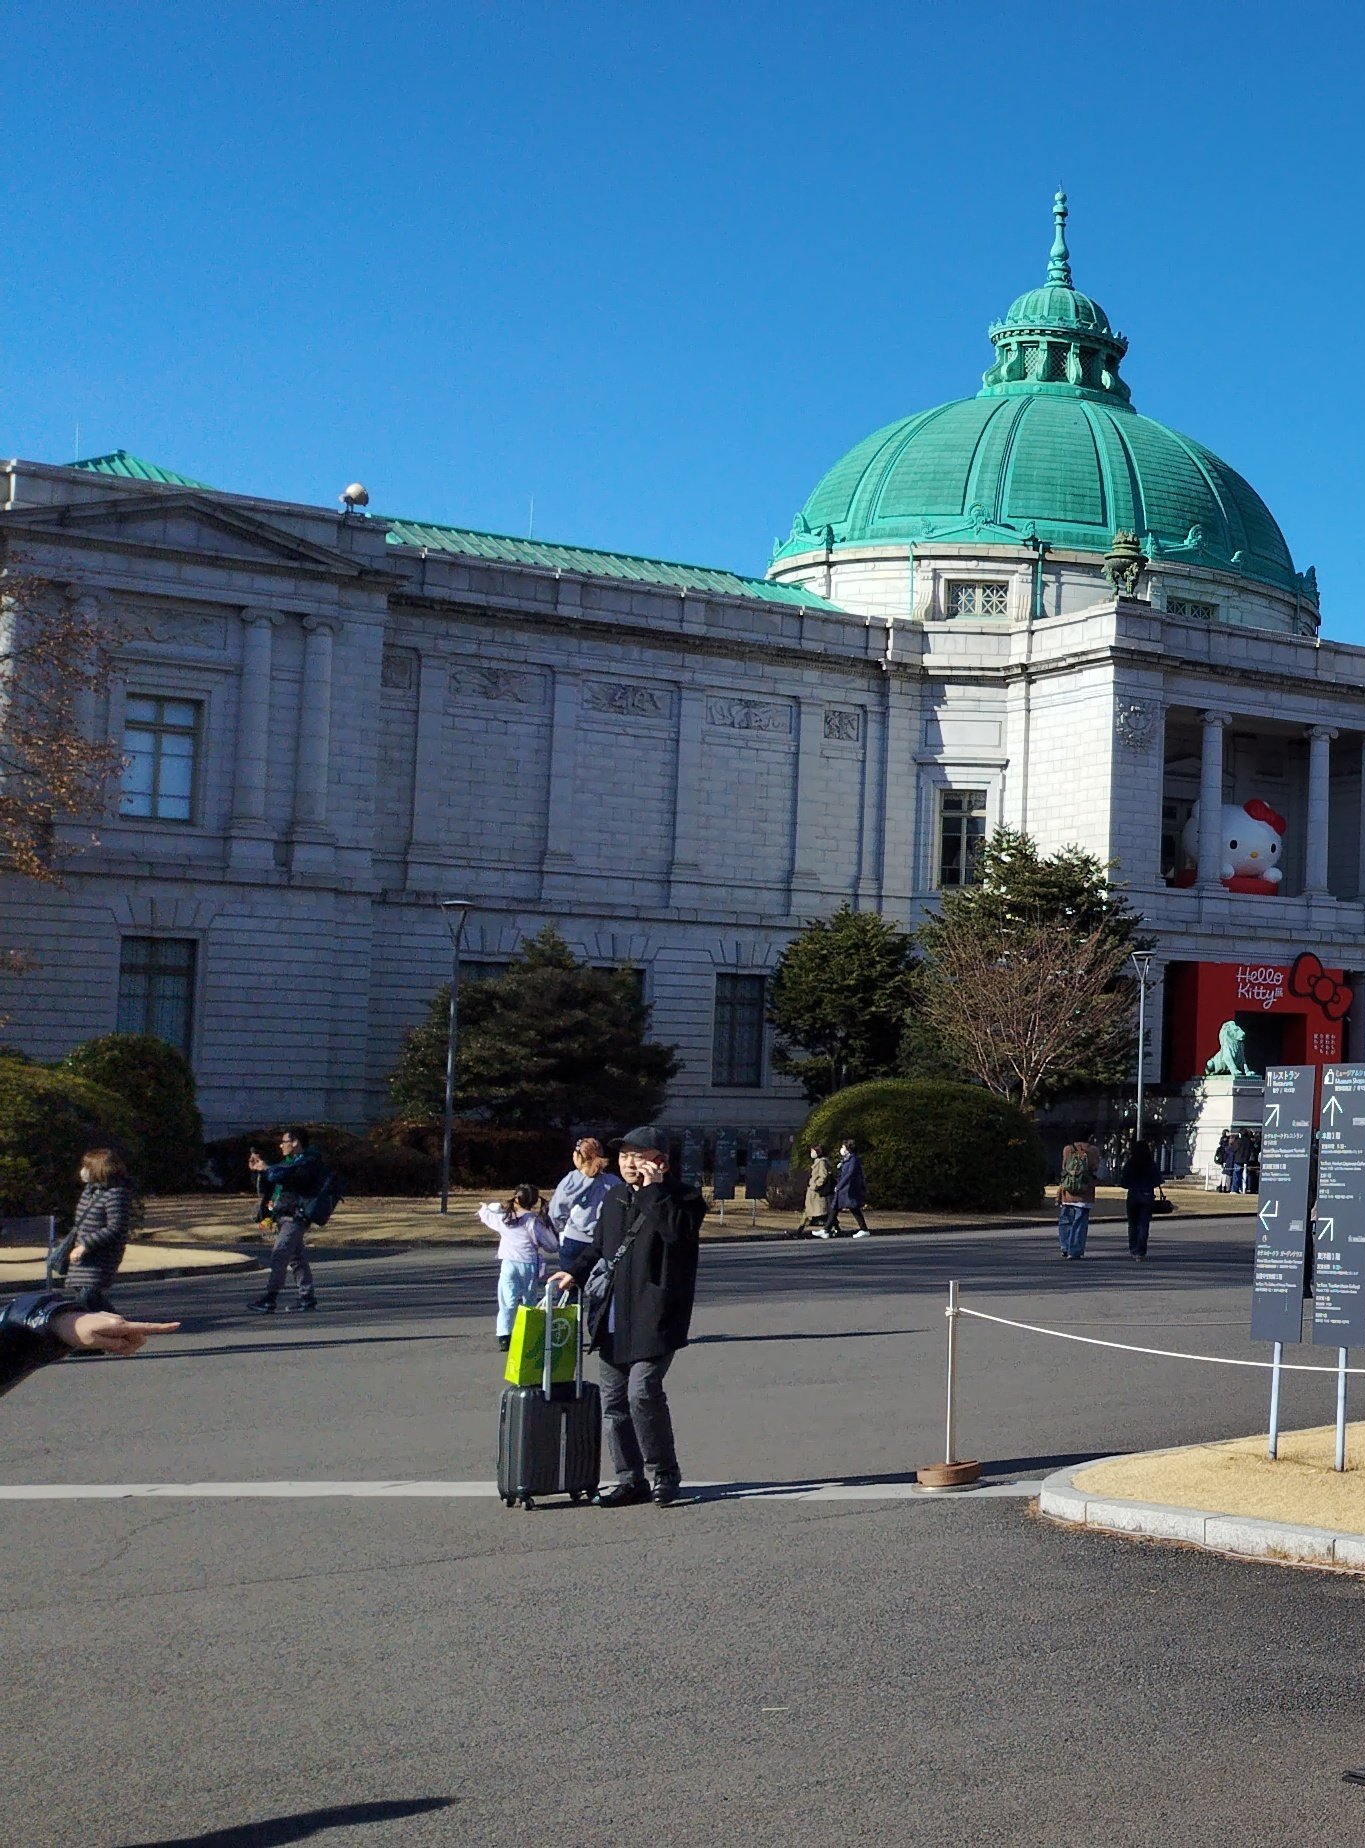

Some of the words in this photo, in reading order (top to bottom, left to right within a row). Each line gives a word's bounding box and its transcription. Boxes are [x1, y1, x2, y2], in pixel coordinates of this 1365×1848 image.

[1236, 966, 1284, 985] Hello
[1273, 1070, 1300, 1080] レストラン
